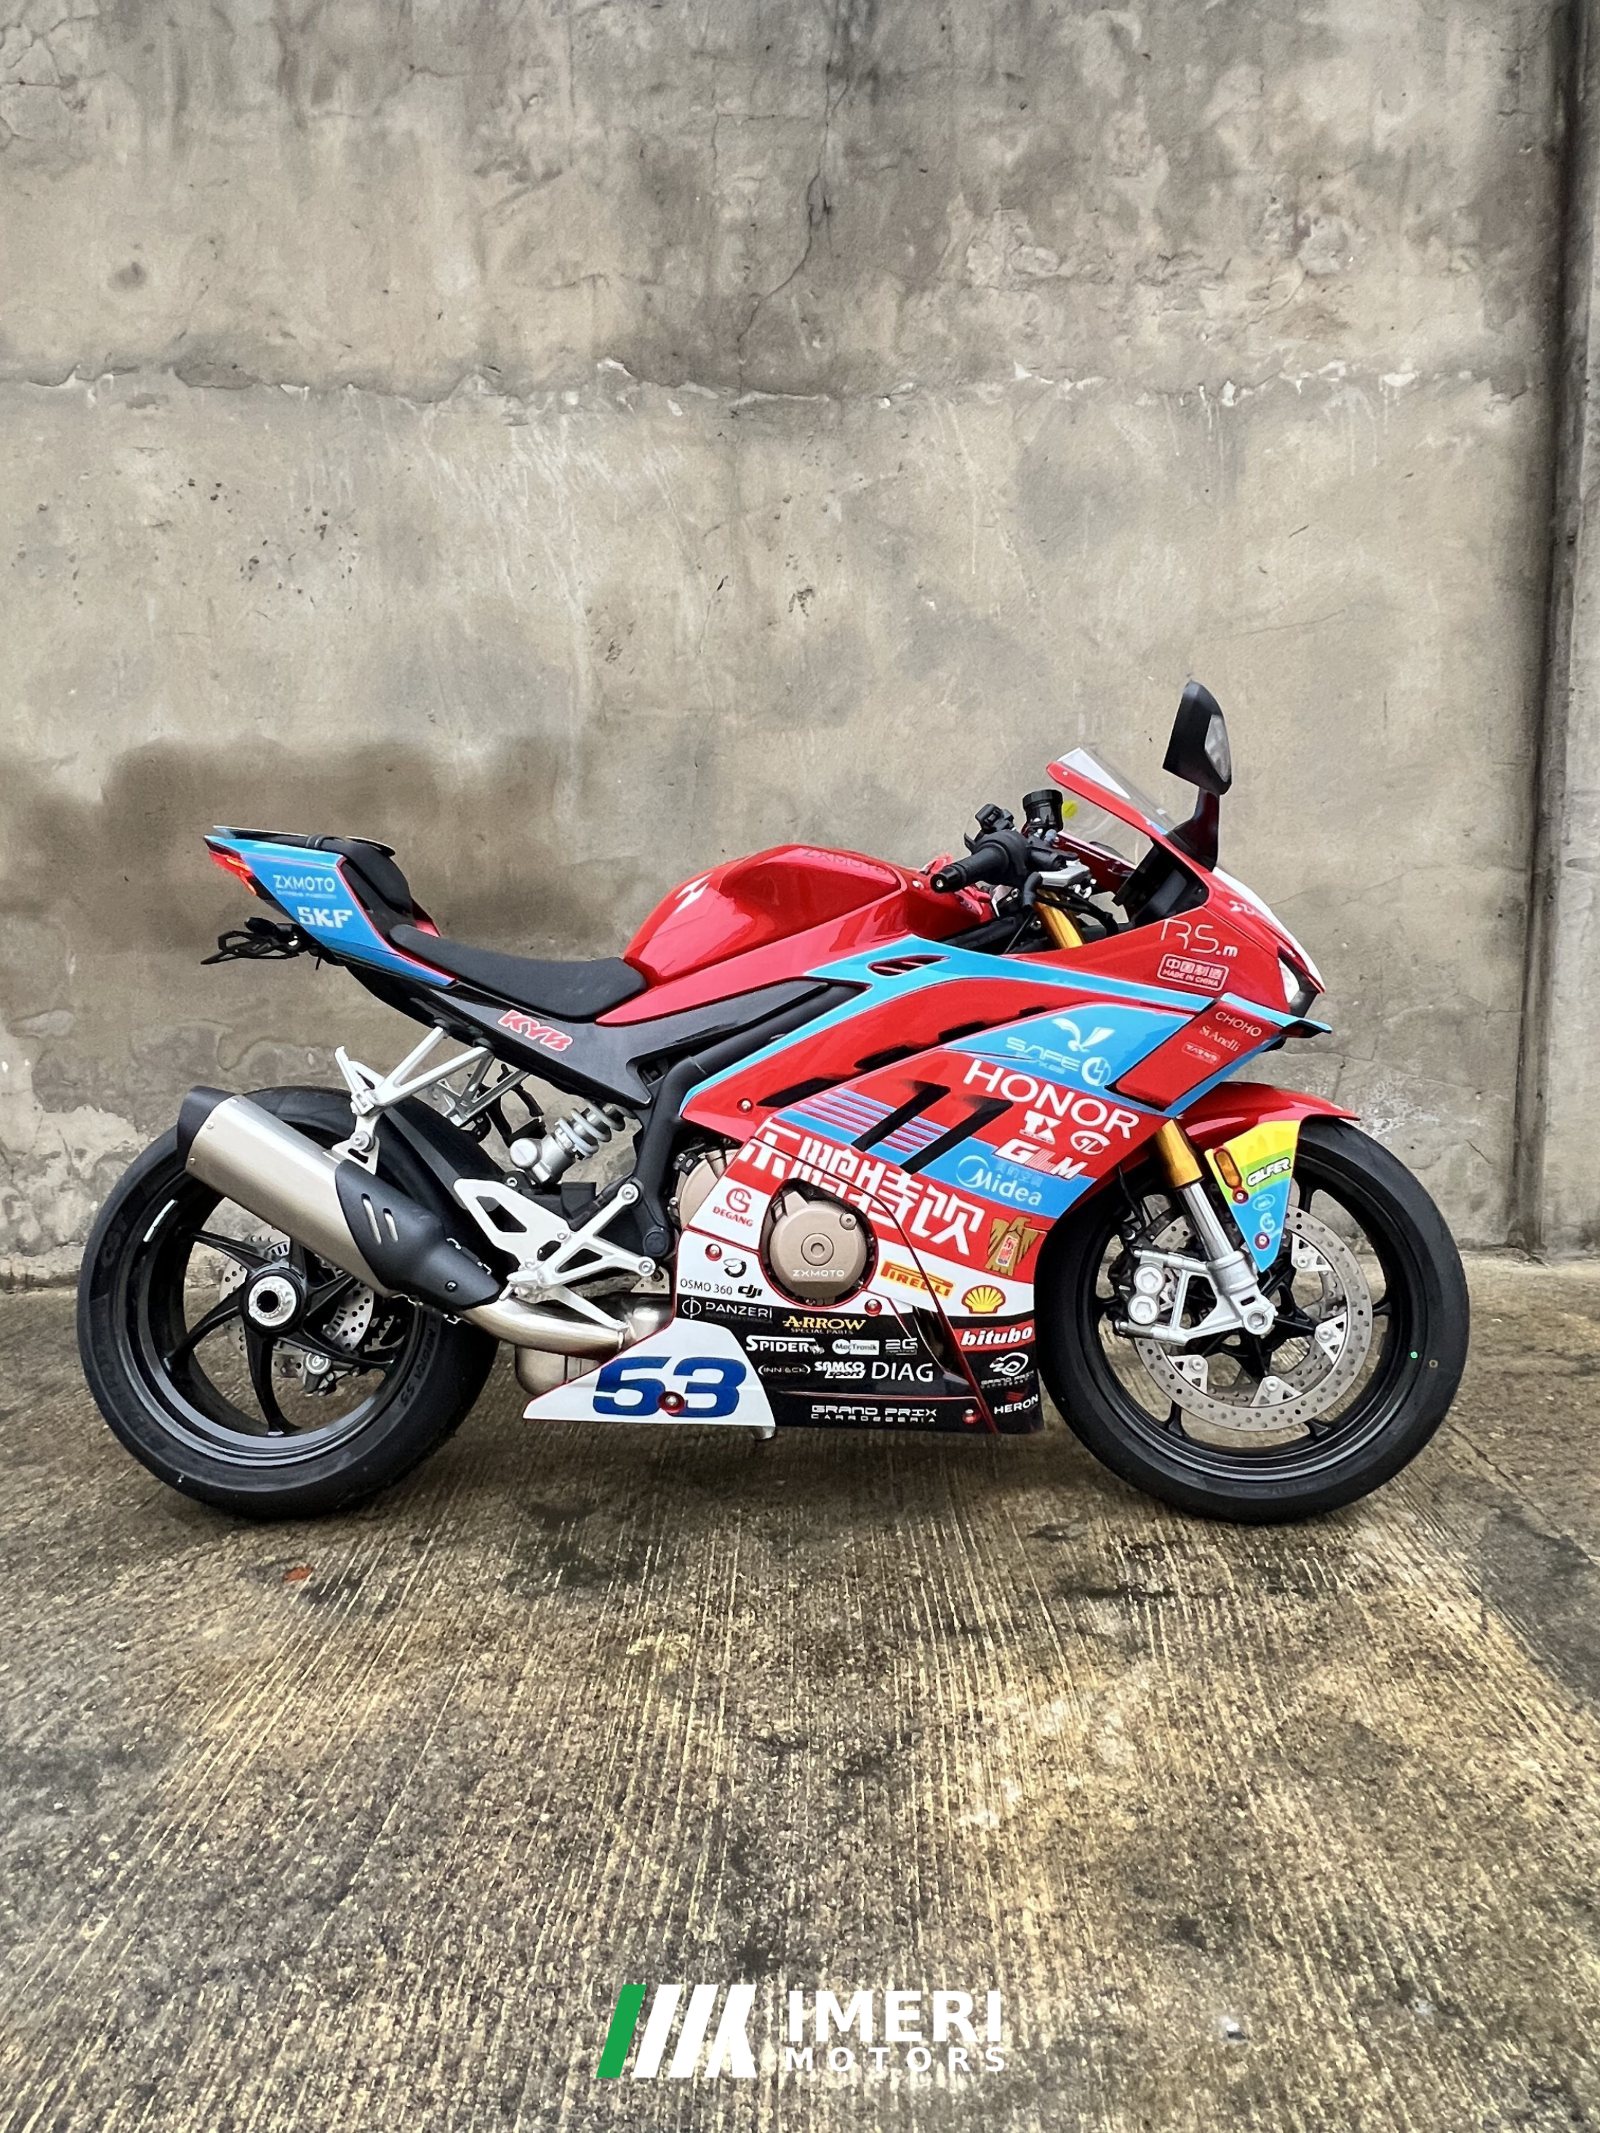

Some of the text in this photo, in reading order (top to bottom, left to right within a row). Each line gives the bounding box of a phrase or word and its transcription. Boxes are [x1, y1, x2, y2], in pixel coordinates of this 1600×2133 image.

[273, 874, 336, 892] ZXMOTO
[297, 906, 352, 928] SKF
[1162, 969, 1219, 987] MADE IN CHINA
[498, 1009, 573, 1052] KYB
[1215, 1011, 1262, 1037] CHOHO
[1005, 1036, 1081, 1072] SAFE
[963, 1059, 1140, 1139] HONOR
[966, 1167, 1043, 1207] Midea
[712, 1206, 753, 1227] DEGANG
[792, 1269, 845, 1277] ZXMOTO
[880, 1261, 954, 1298] PIRELLI
[680, 1278, 733, 1296] OSMO 360
[705, 1301, 773, 1319] PANZERI
[782, 1316, 866, 1330] ARROW
[746, 1335, 812, 1354] SPIDER
[961, 1327, 1033, 1346] bitubo
[871, 1361, 934, 1382] DIAG
[592, 1356, 746, 1418] 53
[811, 1405, 937, 1417] GRAND PRIX
[993, 1394, 1039, 1414] HERON
